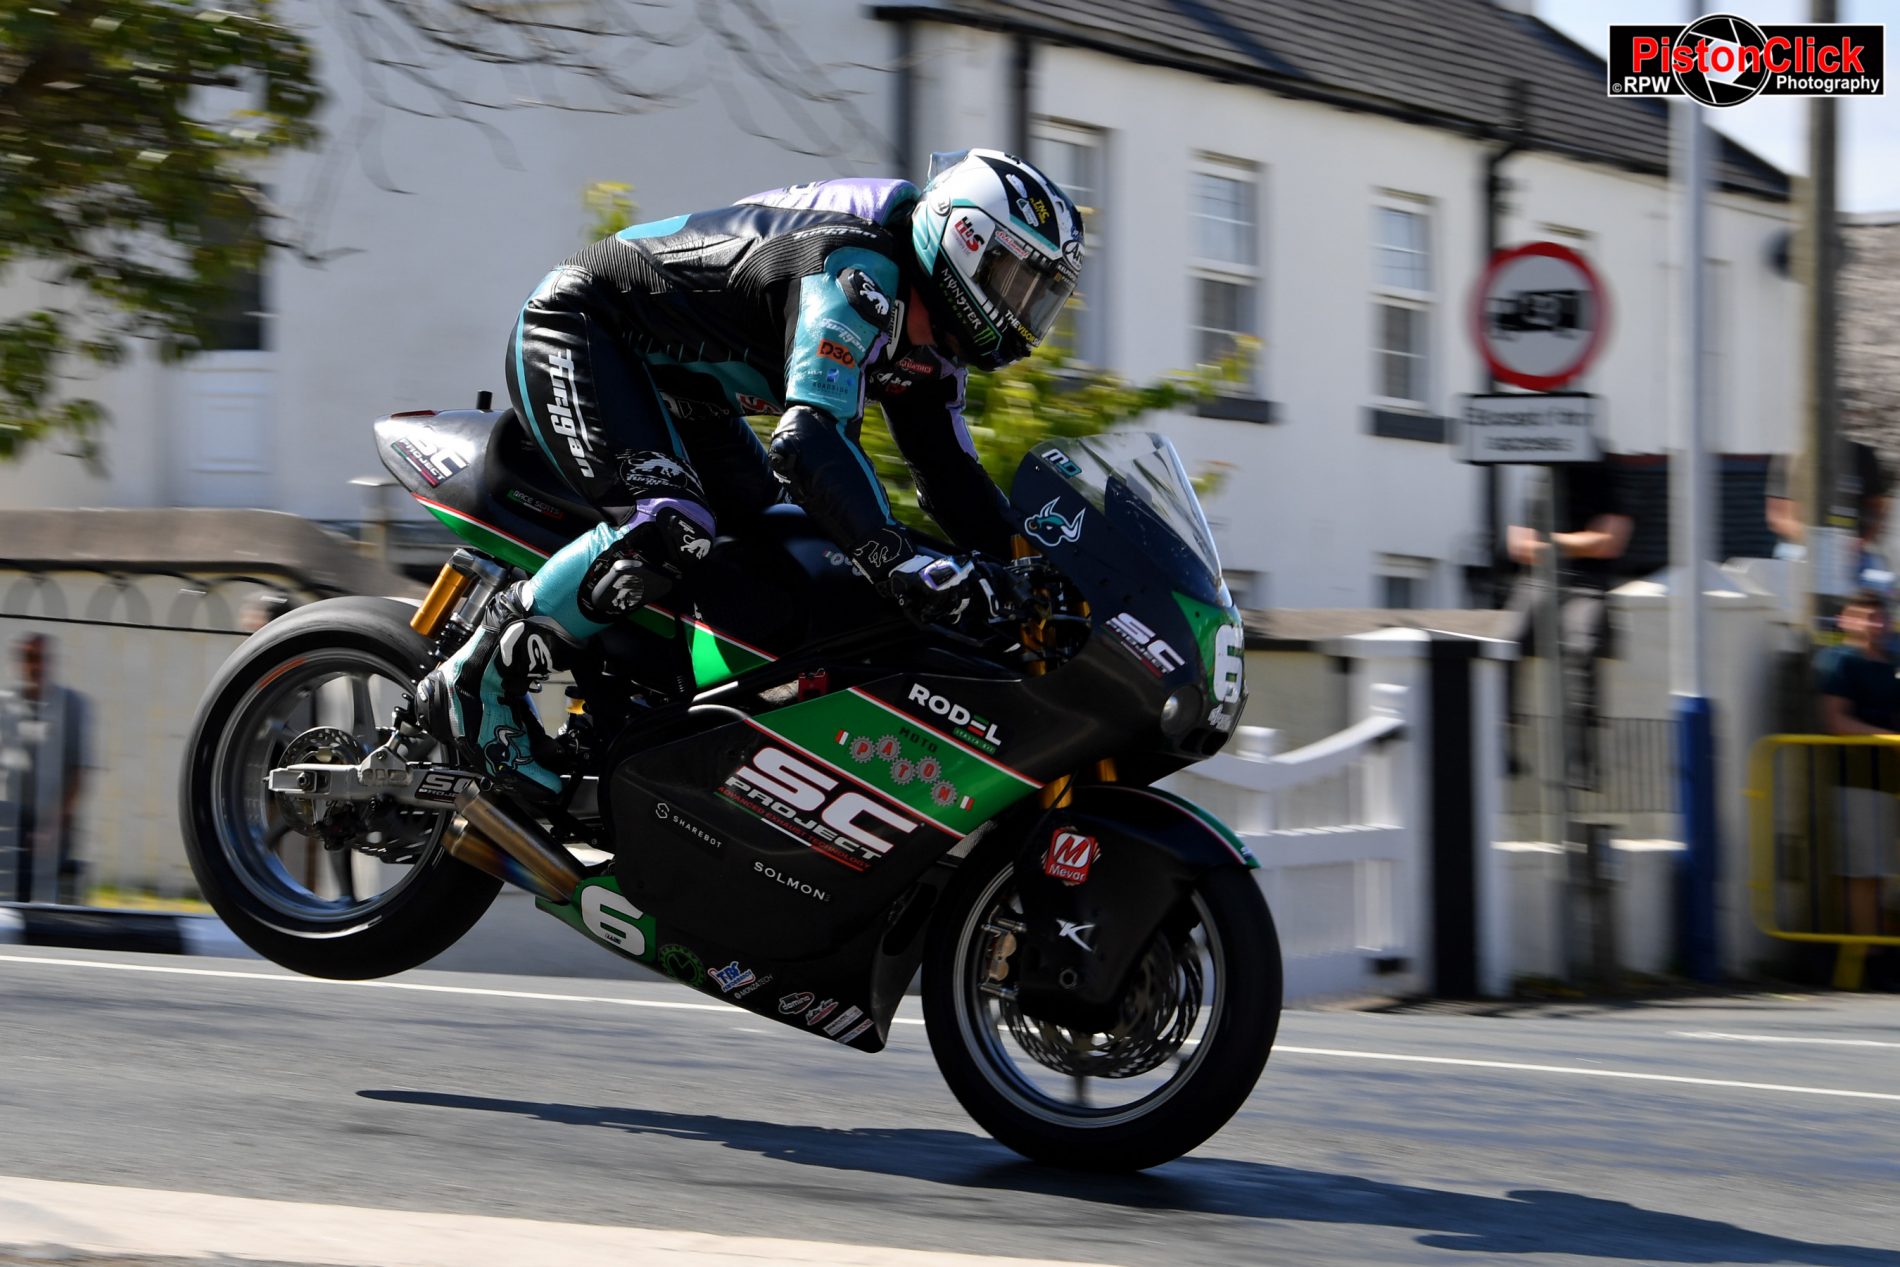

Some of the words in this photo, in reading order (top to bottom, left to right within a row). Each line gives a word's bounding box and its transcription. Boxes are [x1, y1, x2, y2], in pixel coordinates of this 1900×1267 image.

[941, 268, 982, 330] MONSTER
[1111, 612, 1186, 672] SC
[1213, 624, 1244, 704] 6
[856, 740, 951, 801] PATON
[900, 727, 938, 753] MOTO
[672, 815, 723, 848] SHAREBOT
[718, 786, 765, 815] ADVANCED
[808, 834, 872, 868] TECHNOLOGY
[724, 776, 882, 860] PROJECT
[736, 747, 919, 853] SC
[581, 885, 645, 956] 6
